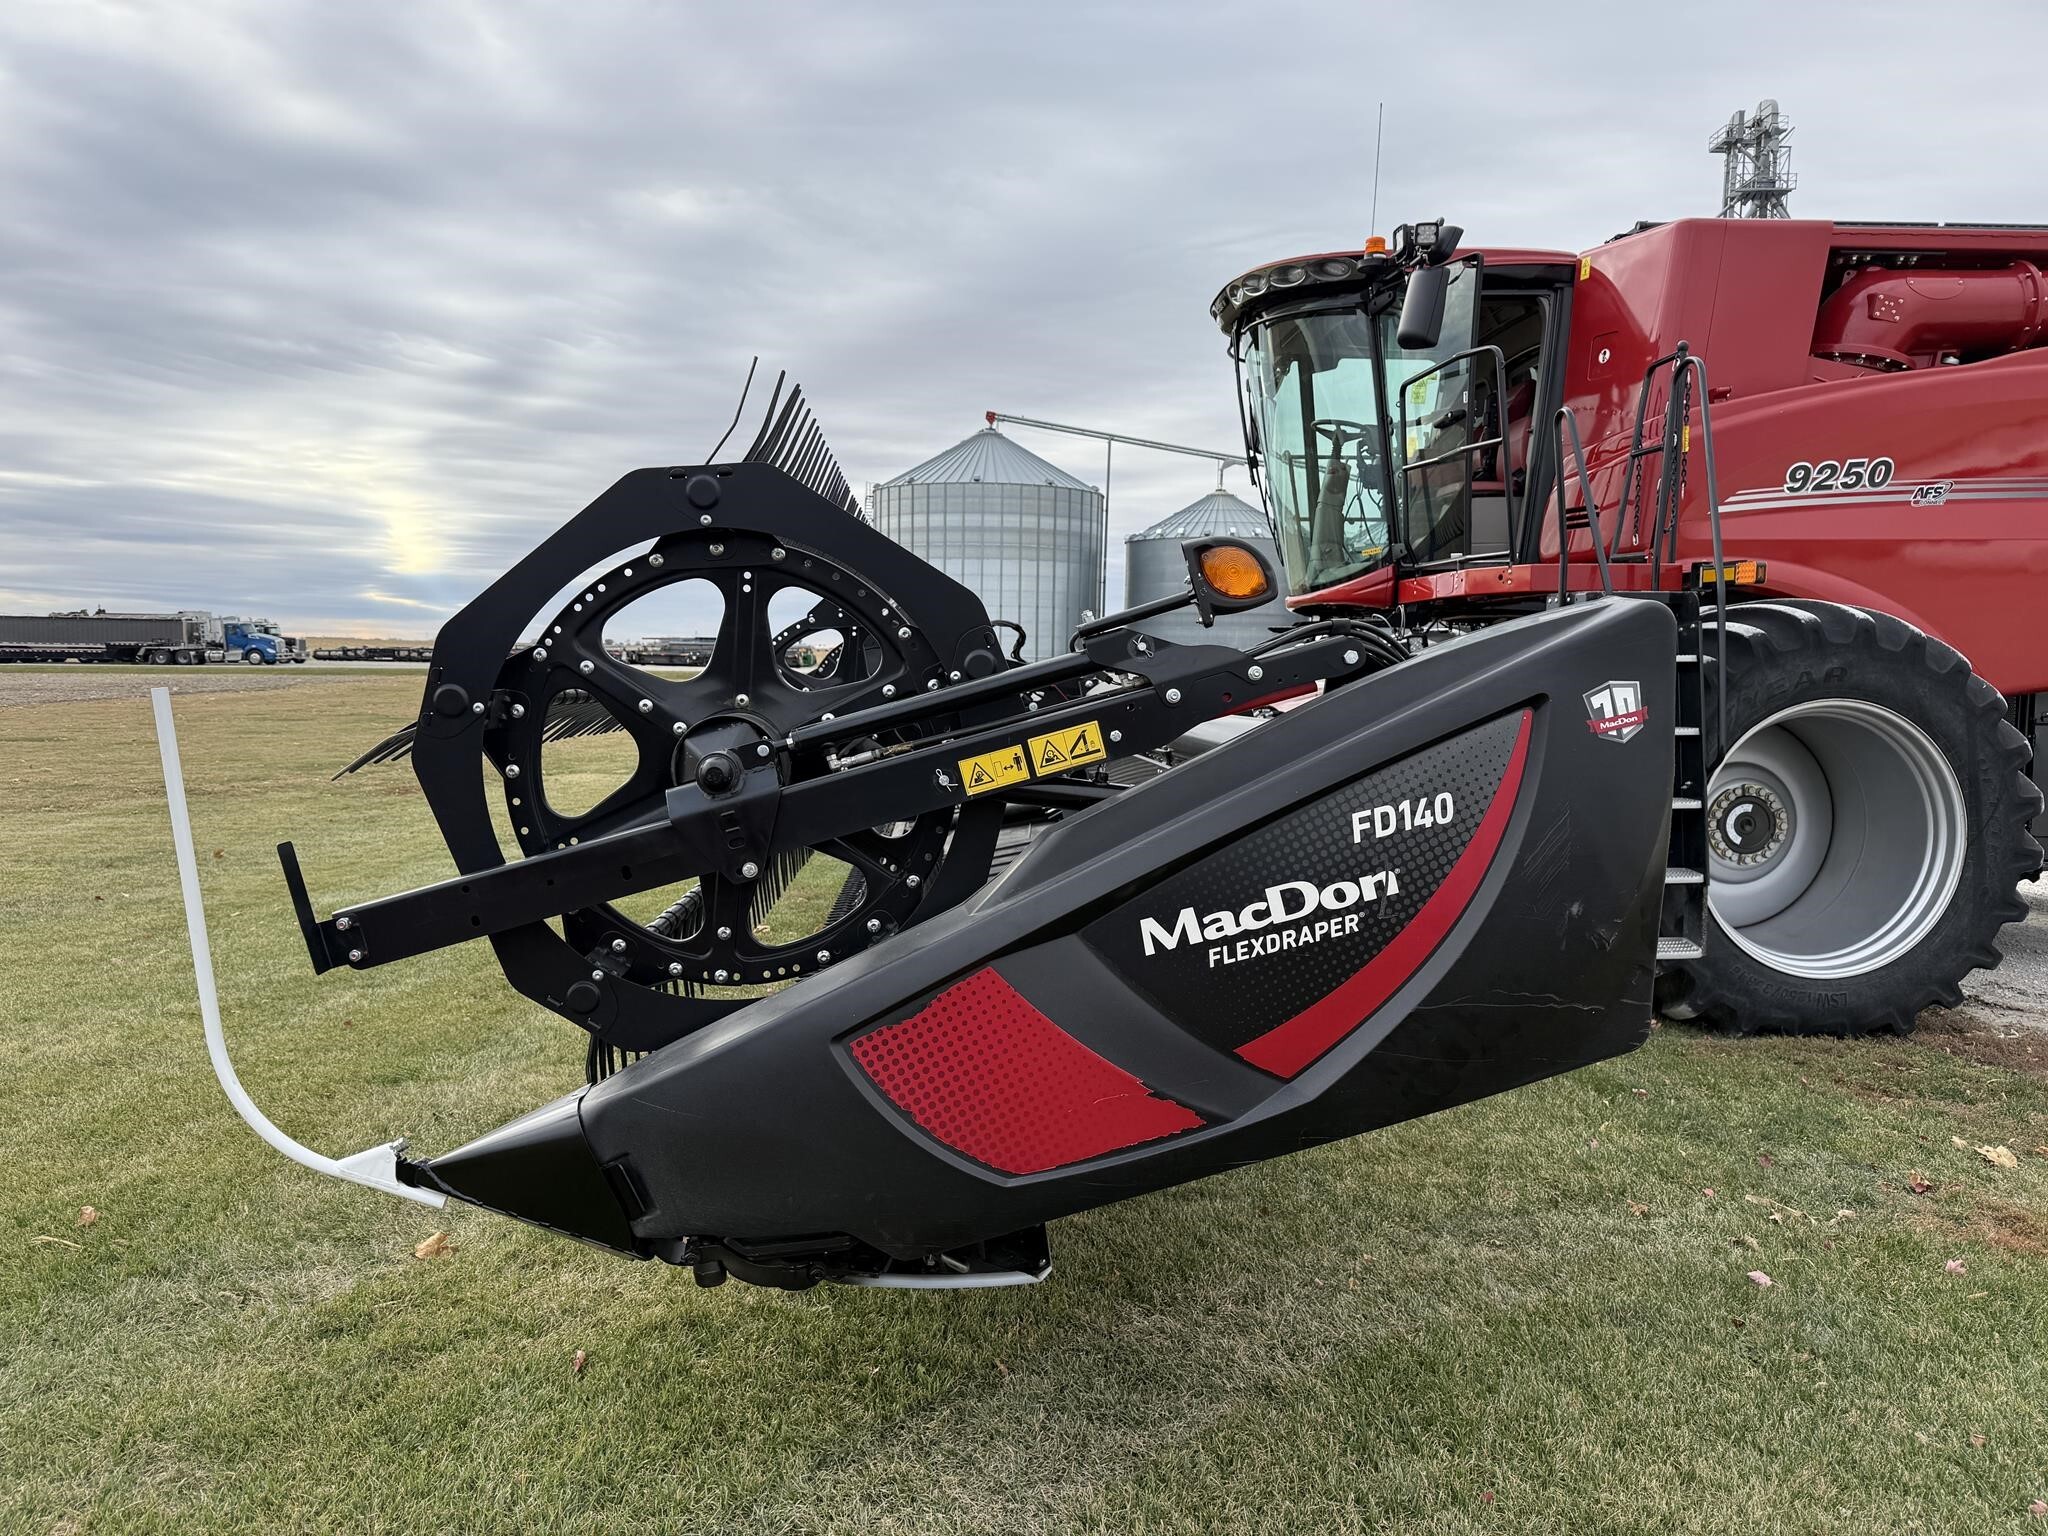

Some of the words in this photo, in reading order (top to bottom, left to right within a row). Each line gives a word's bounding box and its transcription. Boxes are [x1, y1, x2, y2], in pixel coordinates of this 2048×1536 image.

[1784, 457, 1894, 494] 9250
[1912, 486, 1944, 499] AFS
[1600, 716, 1638, 730] MacDon
[1351, 792, 1454, 843] FD140
[1139, 870, 1399, 956] MacDon
[1208, 914, 1359, 968] FLEXDRAPER
